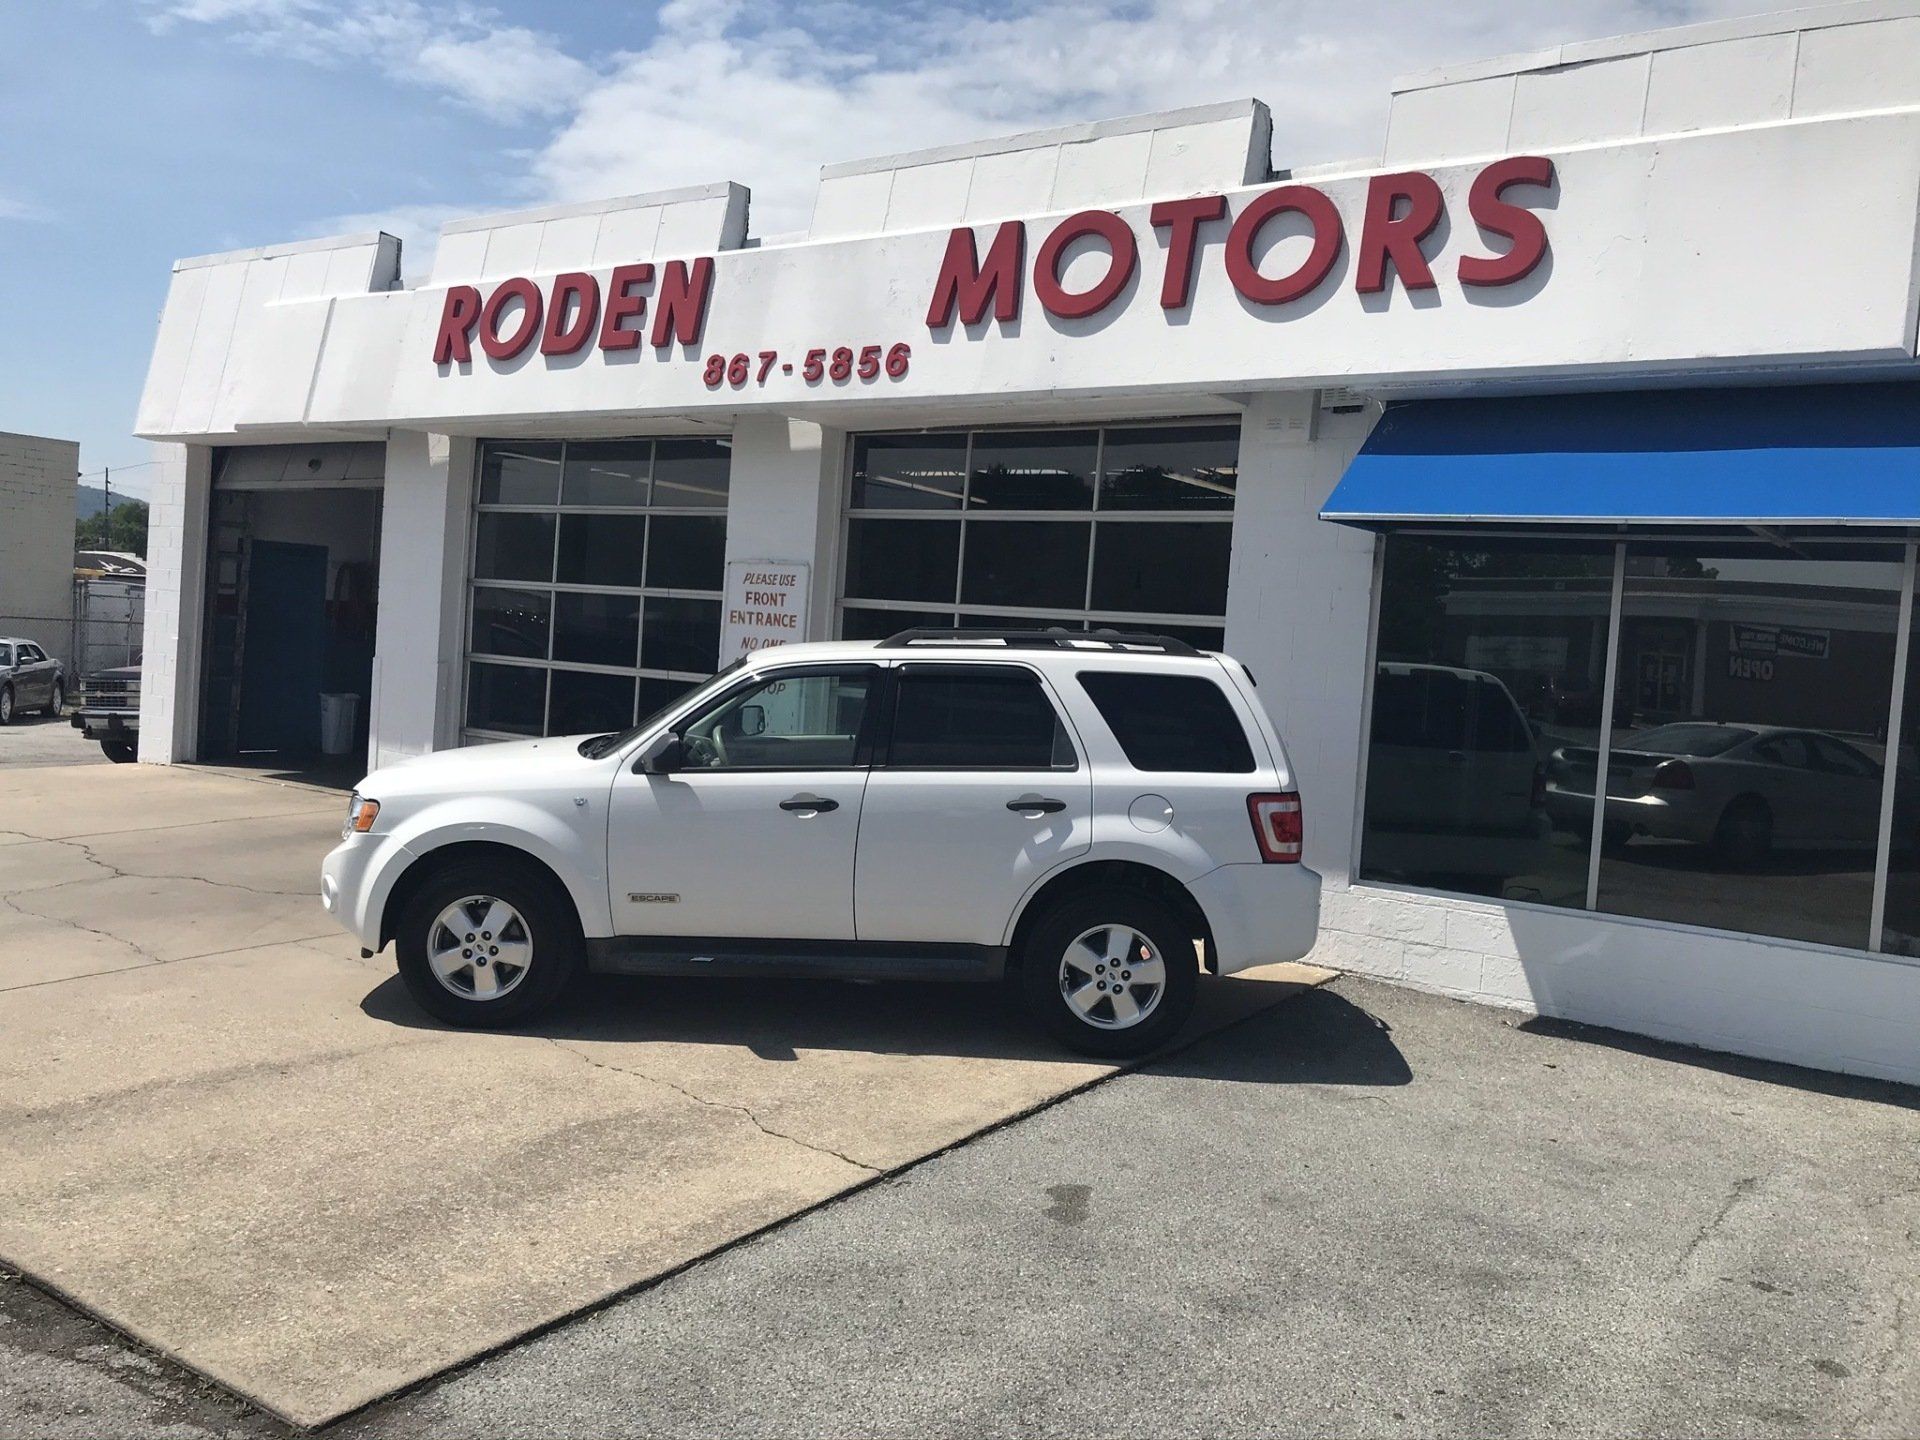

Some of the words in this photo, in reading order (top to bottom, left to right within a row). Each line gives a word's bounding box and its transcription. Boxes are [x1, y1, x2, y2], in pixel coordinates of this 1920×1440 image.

[434, 257, 713, 363] RODEN
[927, 156, 1554, 326] MOTORS
[704, 343, 910, 387] 867-5856
[743, 572, 778, 587] PLEASE
[778, 574, 797, 587] USE
[745, 591, 787, 608] FRONT
[729, 610, 798, 628] ENTRANCE
[740, 637, 758, 650] NO
[762, 682, 786, 696] OP
[631, 895, 677, 903] ESCAPE
